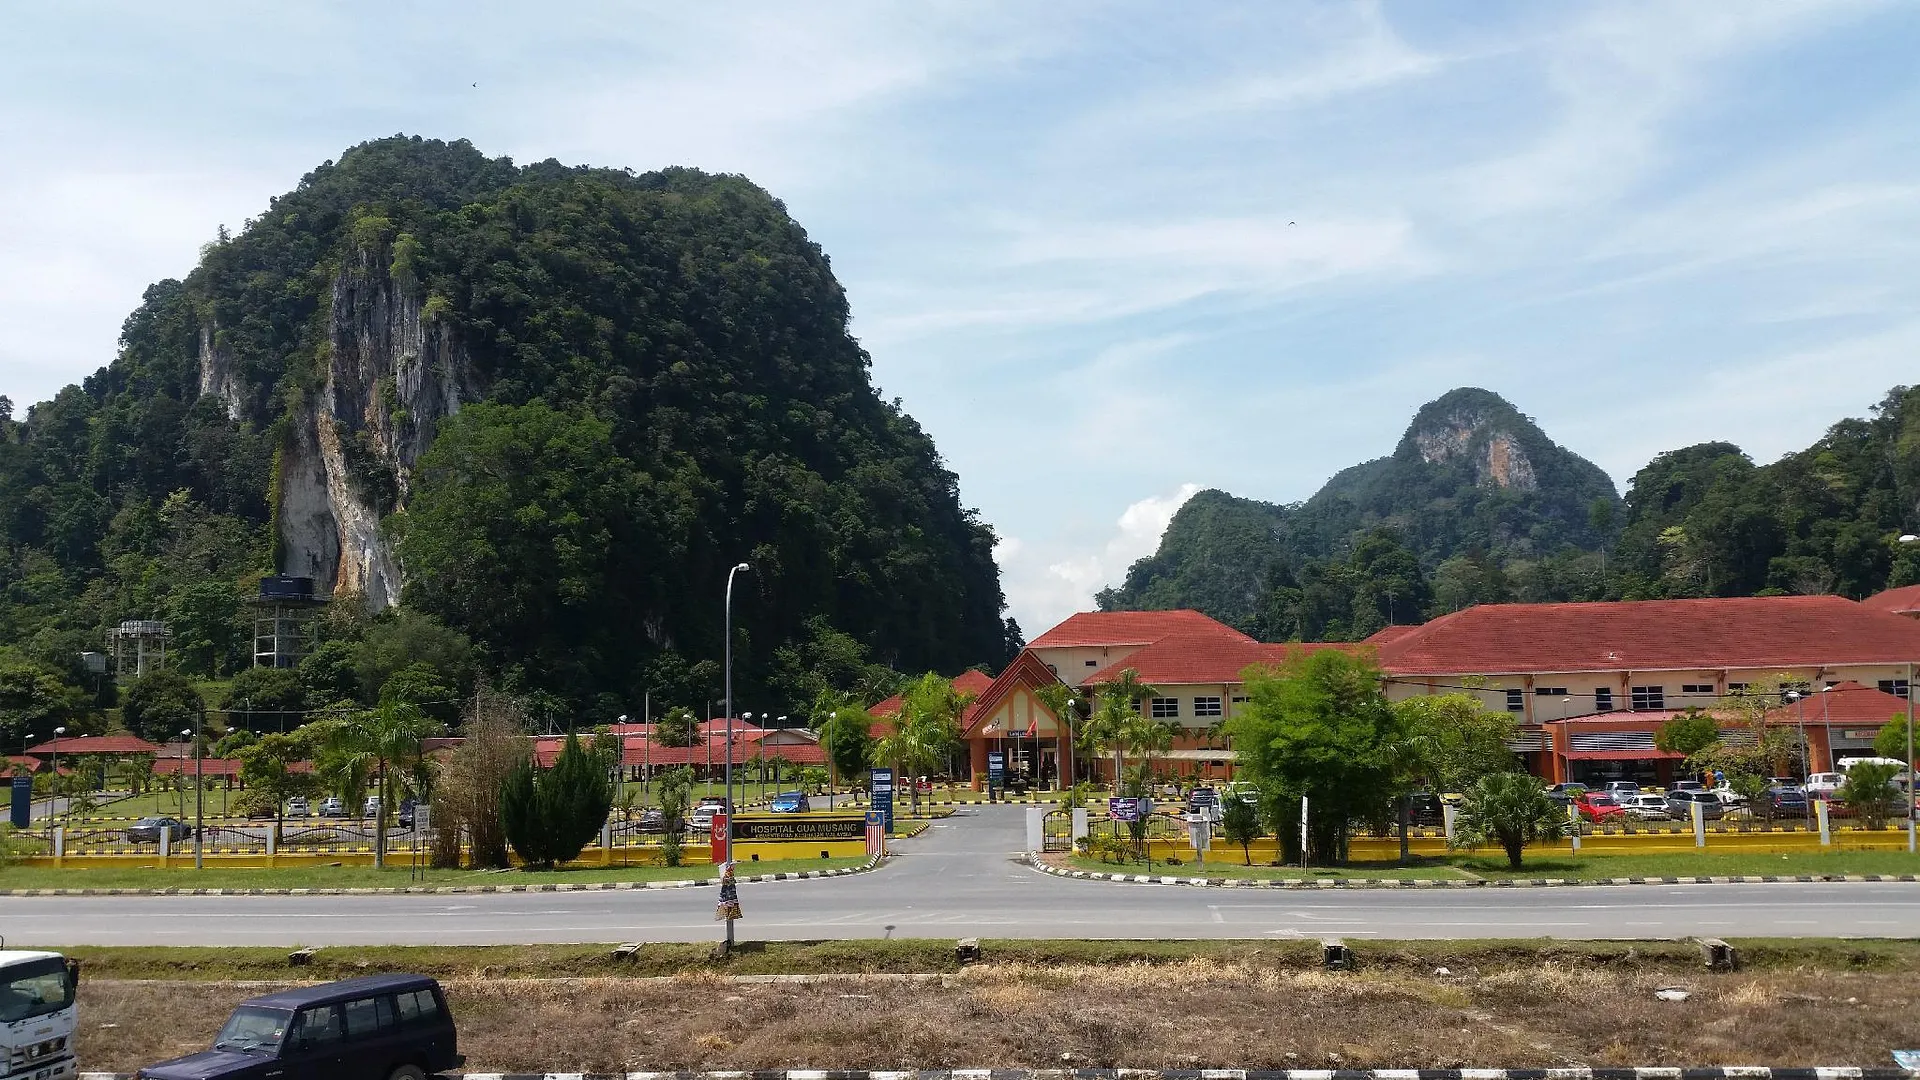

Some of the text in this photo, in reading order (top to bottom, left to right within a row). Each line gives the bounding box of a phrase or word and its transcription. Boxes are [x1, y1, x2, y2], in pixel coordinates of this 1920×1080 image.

[750, 823, 857, 833] HOSPITAL GUA MUSANG
